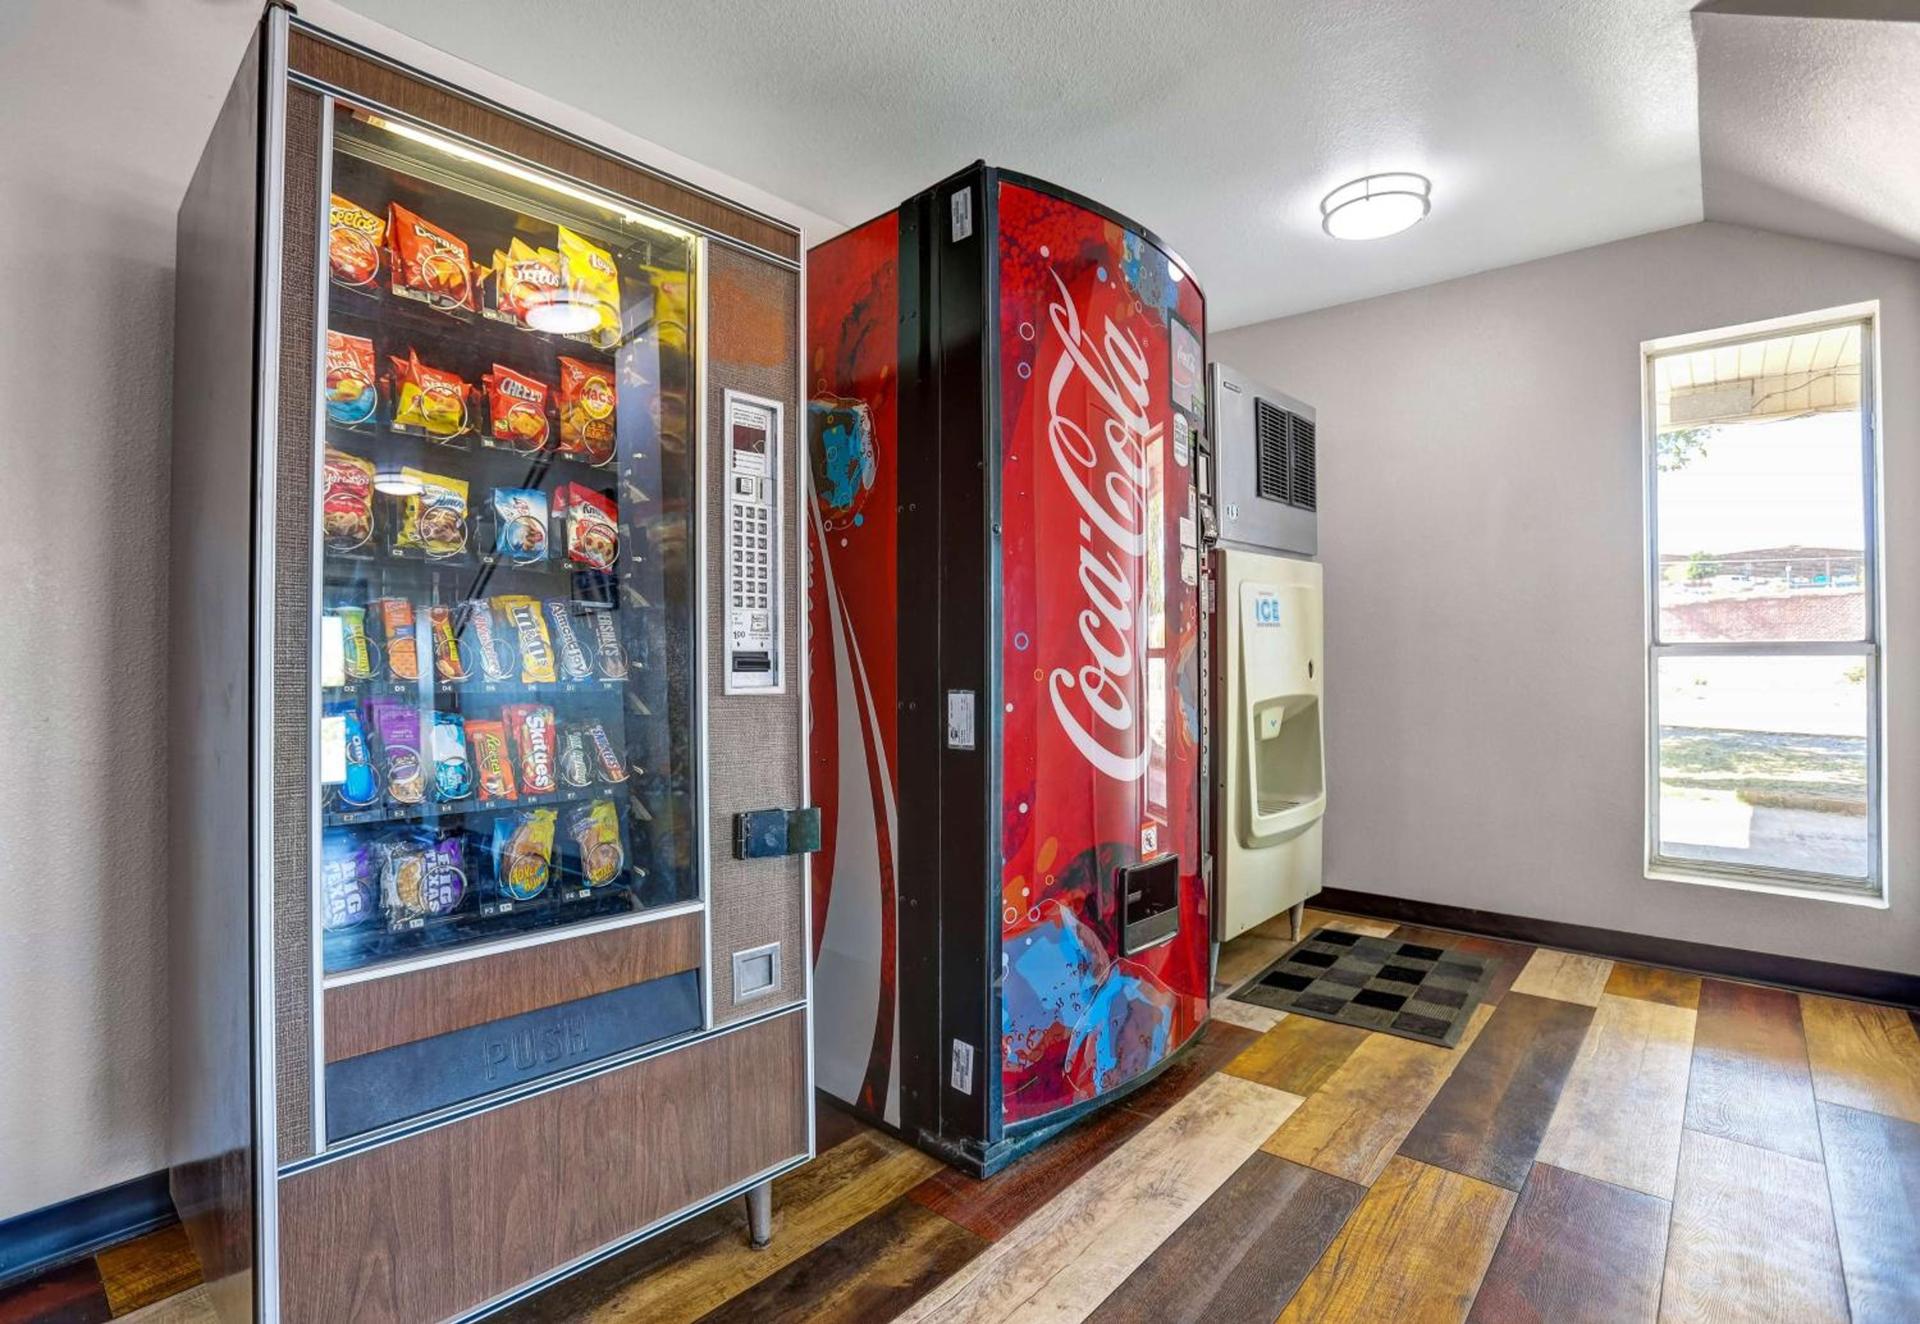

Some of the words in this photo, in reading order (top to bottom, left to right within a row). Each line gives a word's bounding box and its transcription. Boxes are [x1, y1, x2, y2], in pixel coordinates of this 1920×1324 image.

[414, 224, 465, 260] Doritos
[1048, 266, 1150, 782] Coca-Cola
[1255, 598, 1280, 621] ICE
[525, 715, 550, 787] Skittles
[483, 1014, 589, 1081] PUSH
